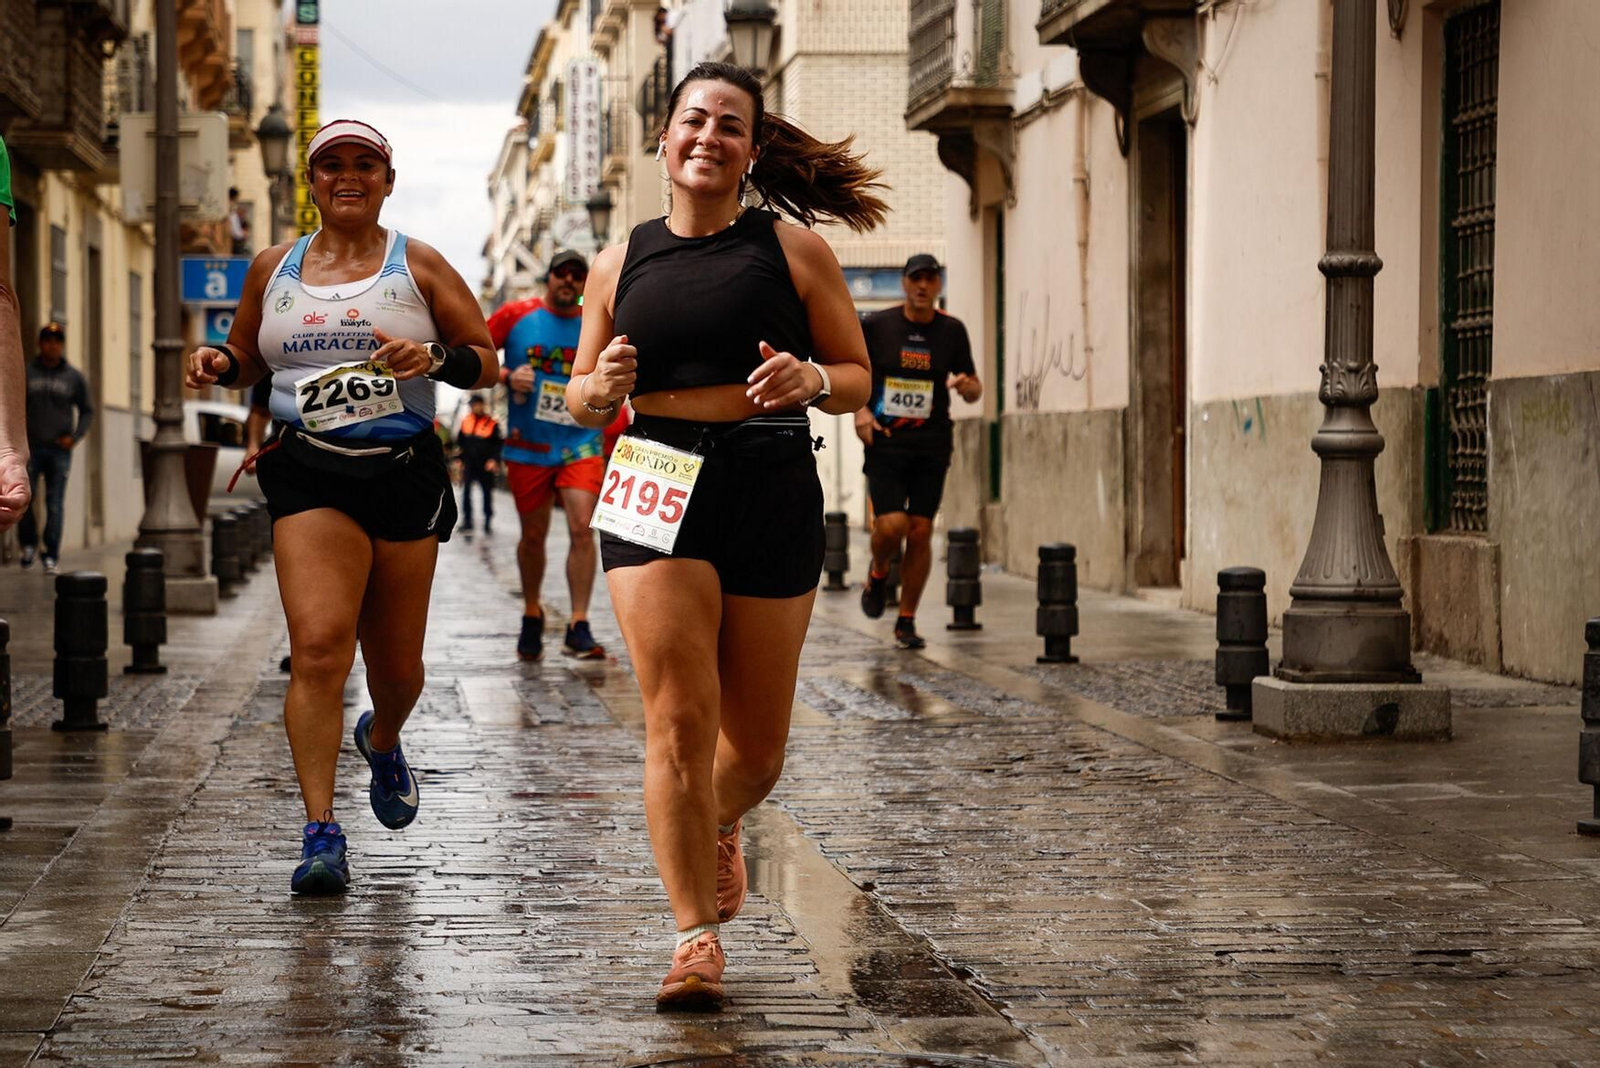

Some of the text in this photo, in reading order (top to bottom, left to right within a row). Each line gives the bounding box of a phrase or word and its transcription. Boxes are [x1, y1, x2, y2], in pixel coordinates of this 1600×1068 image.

[284, 338, 382, 353] MARACEN
[300, 376, 394, 414] 2269
[539, 395, 569, 412] 32
[891, 393, 925, 409] 402
[629, 451, 677, 474] FONDO
[601, 469, 688, 524] 2195
